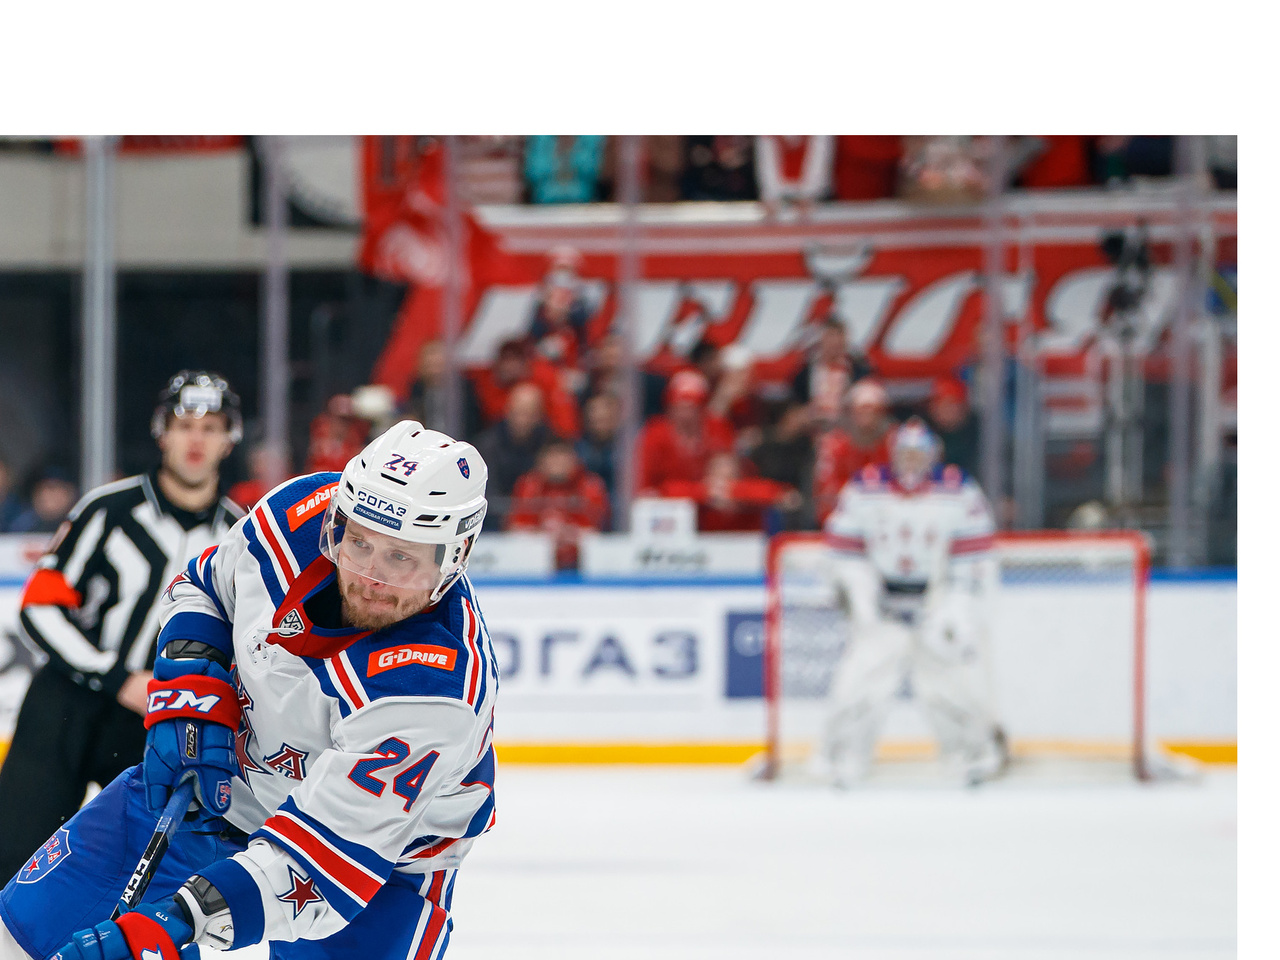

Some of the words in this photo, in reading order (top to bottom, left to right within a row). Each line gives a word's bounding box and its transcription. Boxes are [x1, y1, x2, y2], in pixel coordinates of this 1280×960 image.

[383, 453, 419, 477] 24
[357, 490, 407, 517] СОГАЗ
[147, 688, 222, 714] CM
[347, 736, 441, 813] 24
